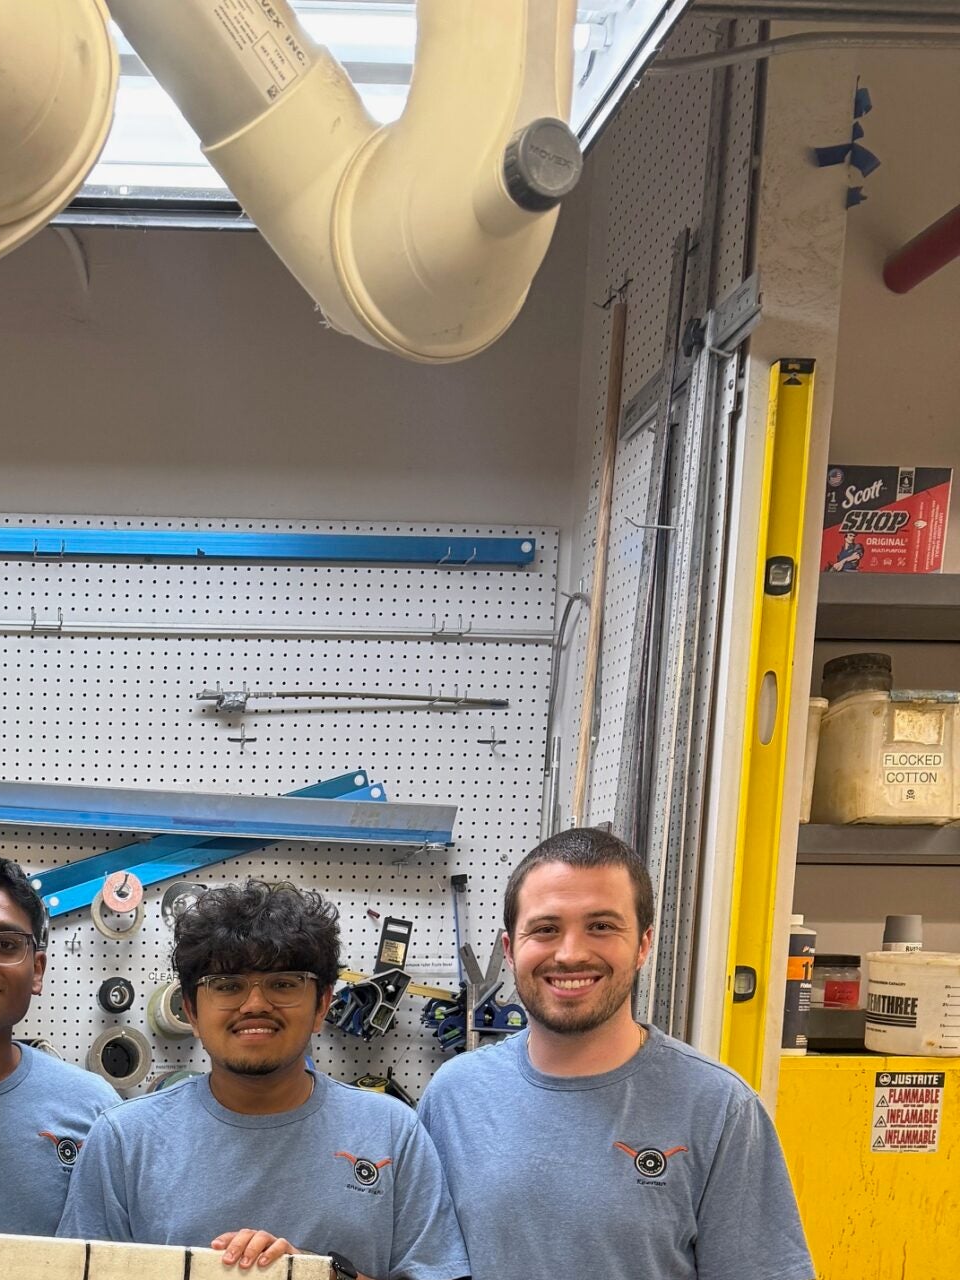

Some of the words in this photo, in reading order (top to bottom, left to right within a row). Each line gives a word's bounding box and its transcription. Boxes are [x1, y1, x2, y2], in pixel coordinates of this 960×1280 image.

[842, 479, 883, 508] Scott
[839, 510, 910, 533] SHOP
[884, 754, 942, 766] FLOCKED
[886, 772, 938, 783] COTTON
[891, 1074, 939, 1085] JUSTRITE
[888, 1088, 940, 1104] FLAMMABLE
[886, 1109, 939, 1124] INFLAMABLE
[885, 1130, 937, 1145] INFLAMMABLE
